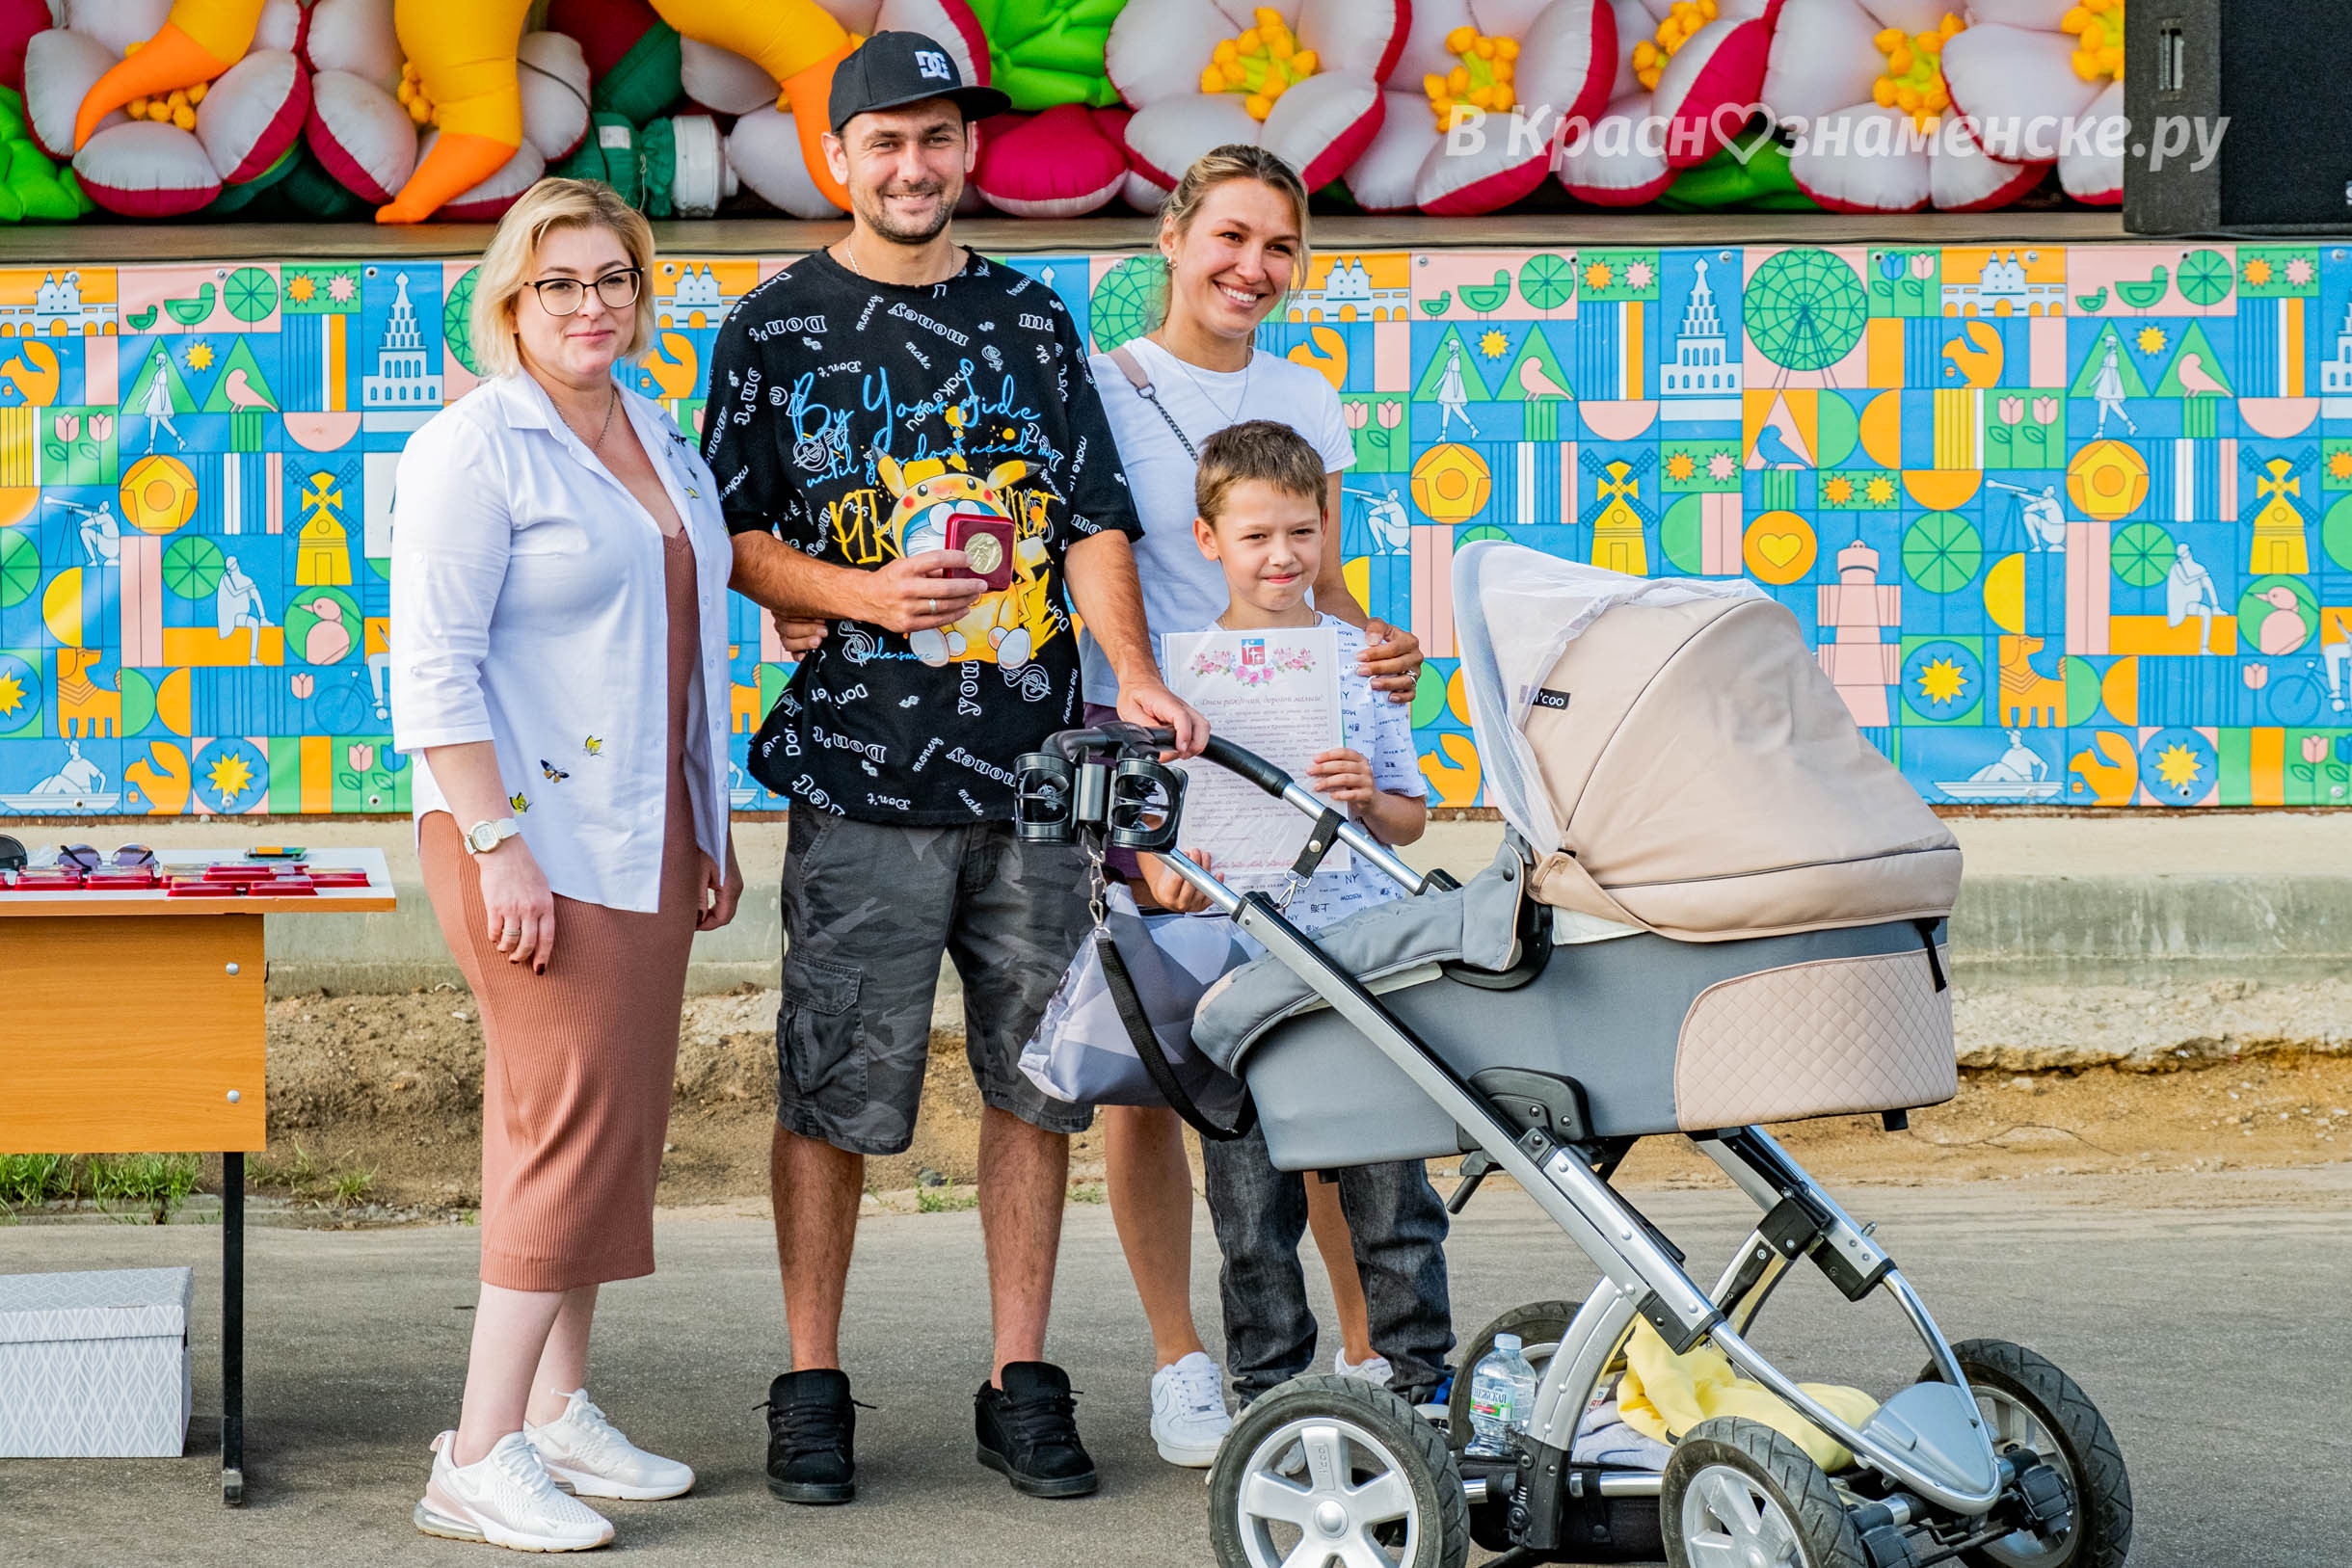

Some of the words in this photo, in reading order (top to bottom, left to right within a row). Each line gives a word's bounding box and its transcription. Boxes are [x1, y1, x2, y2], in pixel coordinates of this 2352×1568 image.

[748, 314, 828, 342] Don't
[855, 294, 885, 332] money
[887, 302, 970, 347] money
[813, 726, 887, 763] Don't
[912, 736, 945, 772] money
